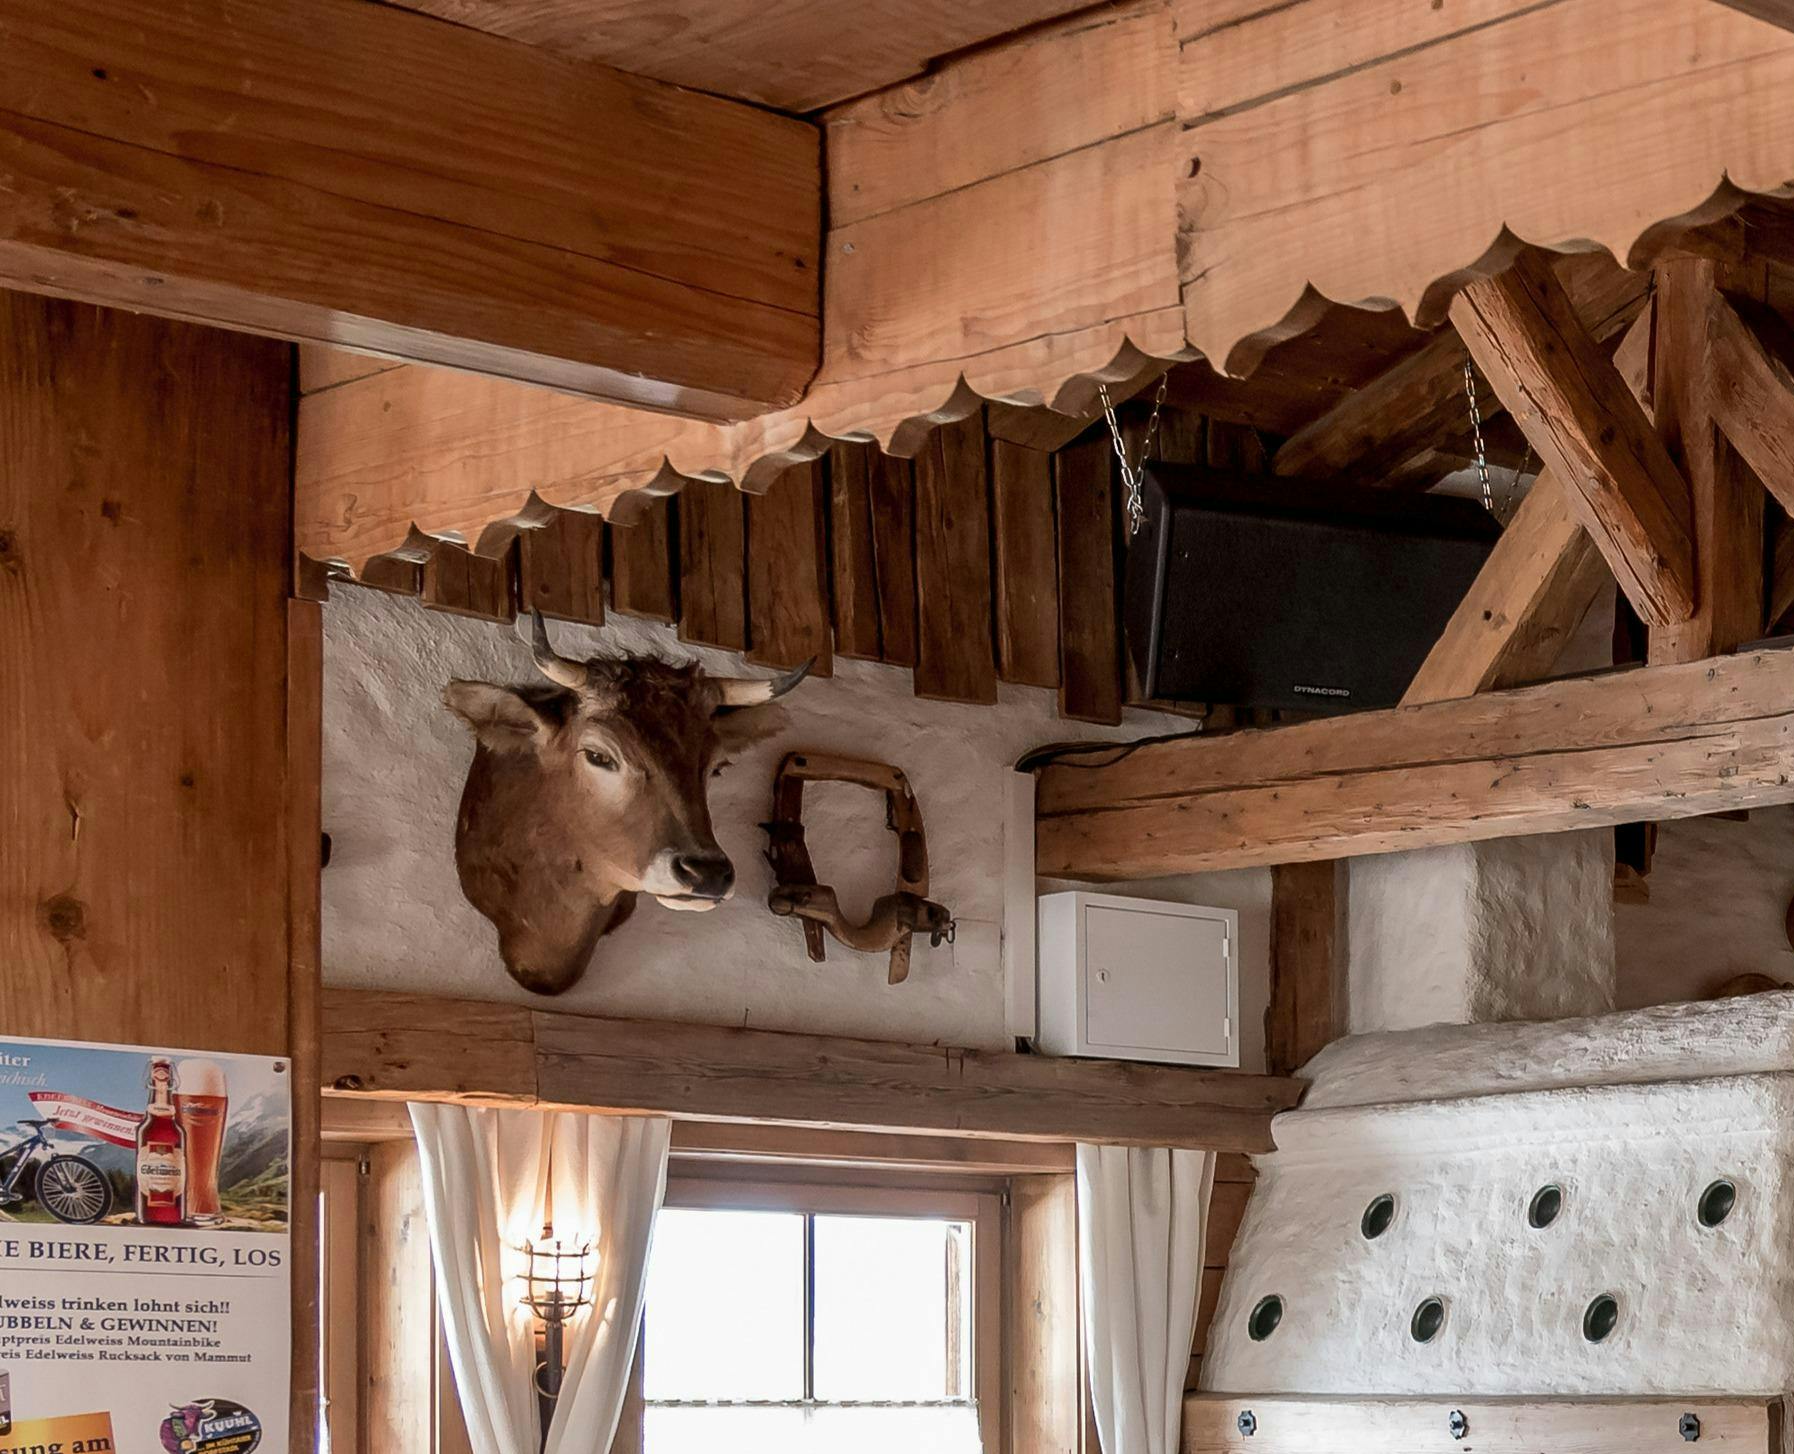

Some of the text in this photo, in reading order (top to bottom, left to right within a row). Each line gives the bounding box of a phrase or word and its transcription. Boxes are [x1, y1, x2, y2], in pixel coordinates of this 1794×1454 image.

[1293, 685, 1350, 697] DYNACORD
[29, 1241, 115, 1263] BIERE,
[123, 1244, 225, 1267] FERTIG,
[233, 1248, 282, 1266] LOS
[61, 1298, 127, 1312] trinken
[134, 1298, 181, 1313] lohnt
[184, 1300, 230, 1314] sich!!
[80, 1317, 95, 1330] &
[101, 1318, 217, 1333] GEWINNEN!
[55, 1335, 123, 1347] Edelweiss
[127, 1335, 221, 1348] Mountainbike
[26, 1350, 95, 1361] Edelweiss
[99, 1350, 161, 1362] Rucksack
[166, 1352, 190, 1362] von
[194, 1353, 252, 1363] Mammut
[72, 1438, 111, 1452] am
